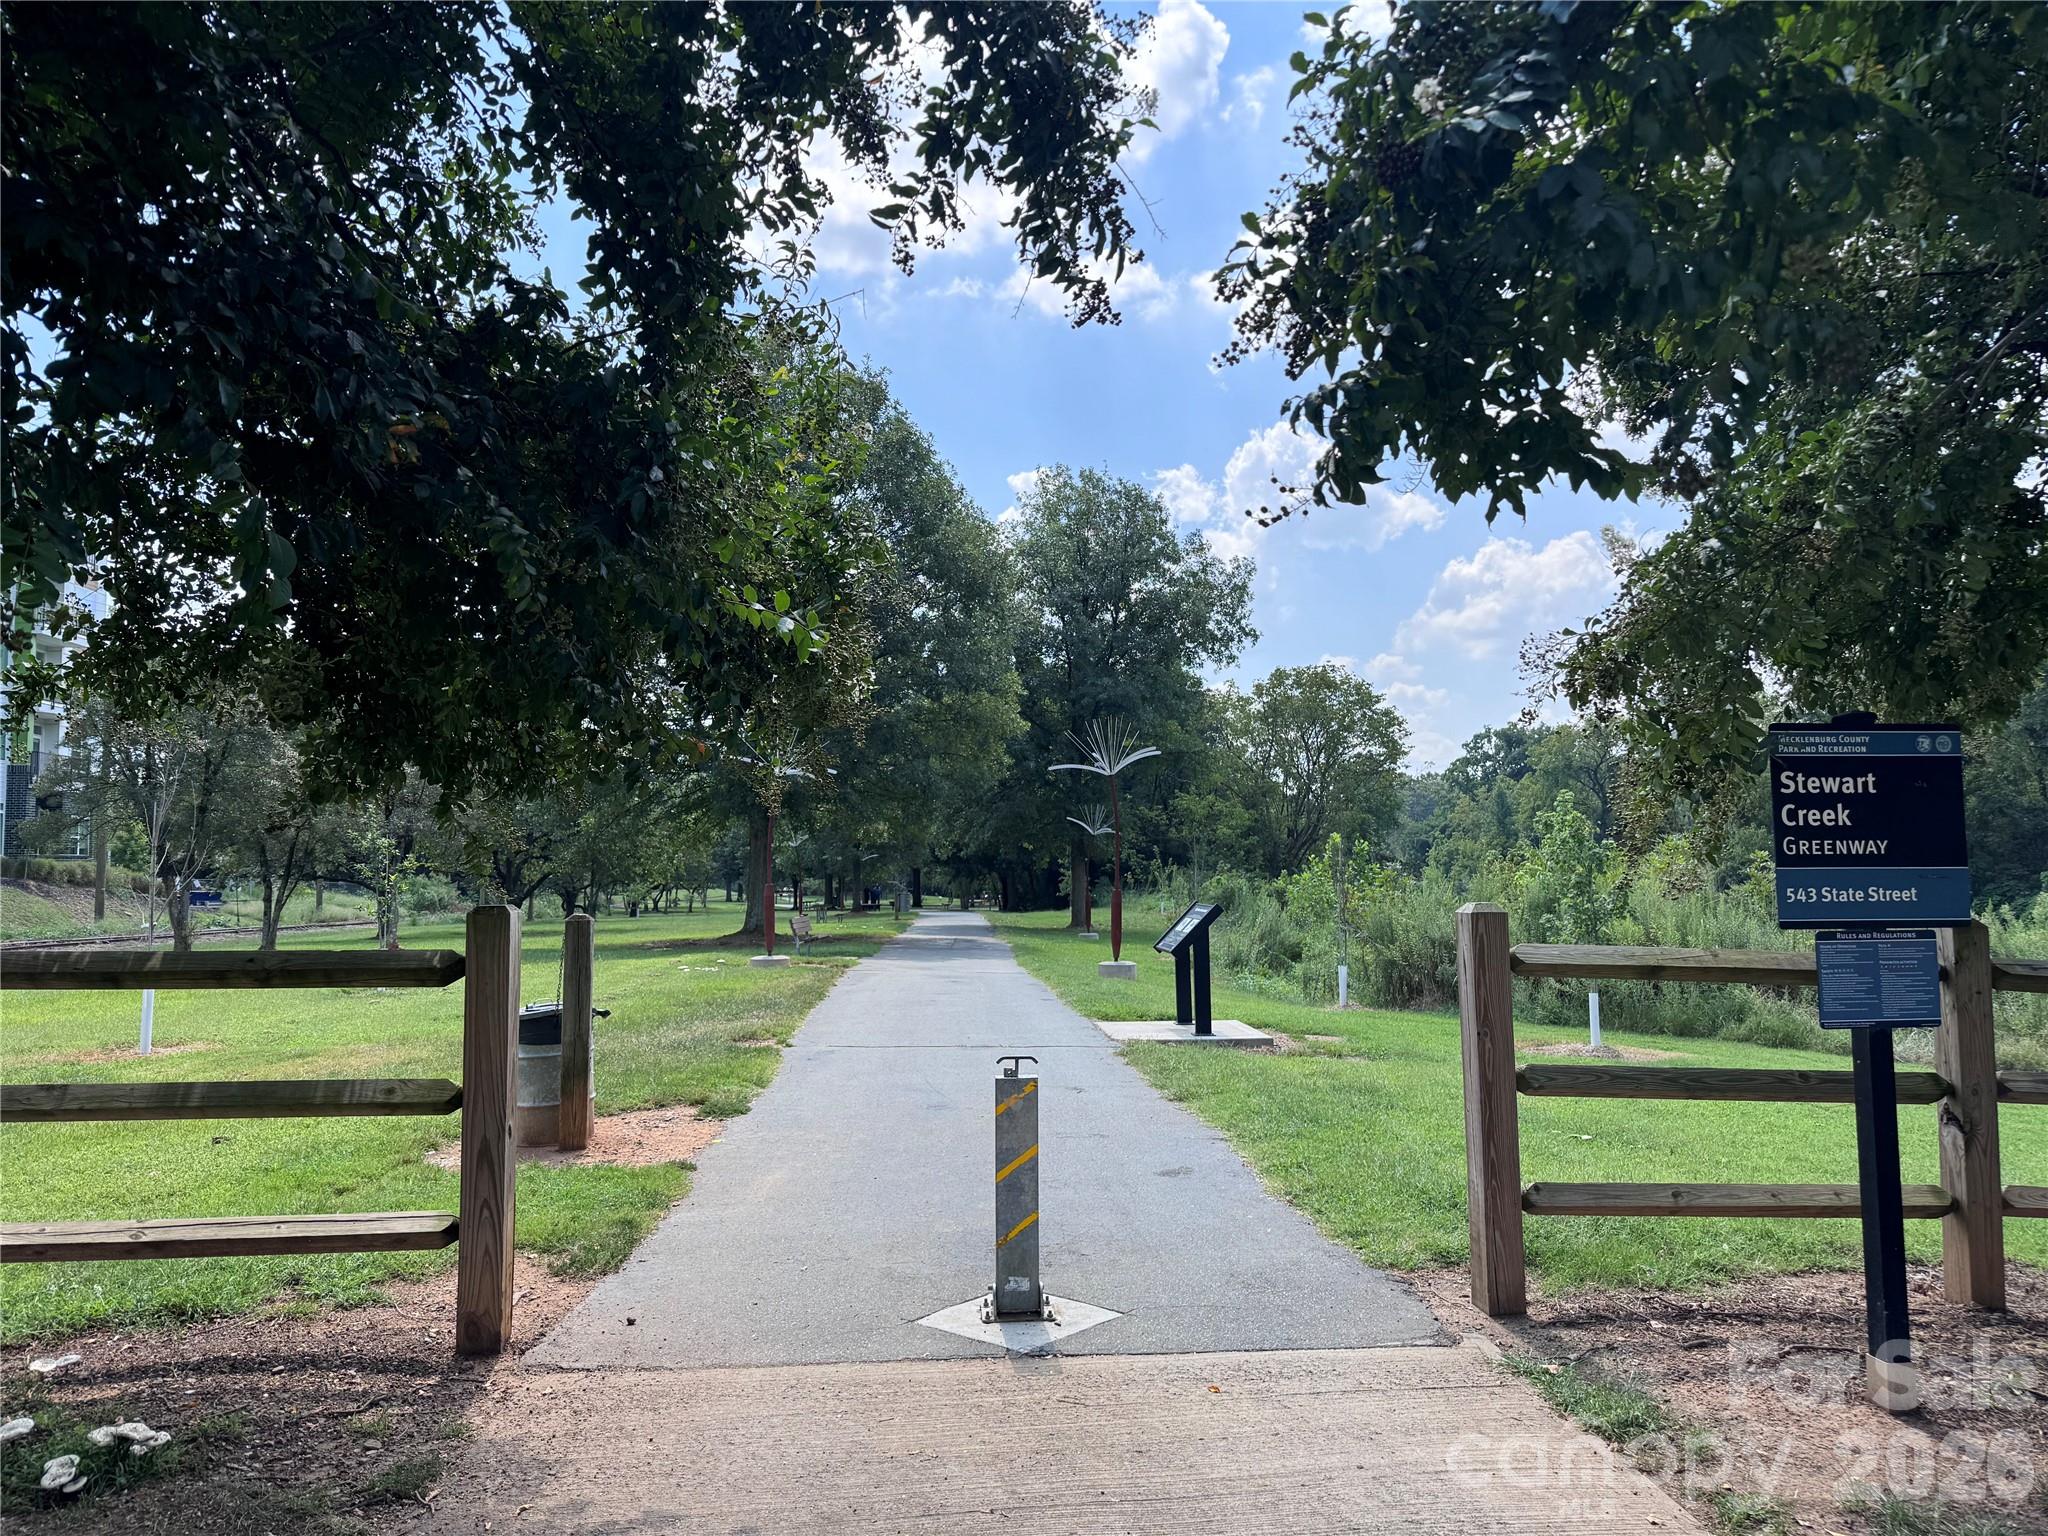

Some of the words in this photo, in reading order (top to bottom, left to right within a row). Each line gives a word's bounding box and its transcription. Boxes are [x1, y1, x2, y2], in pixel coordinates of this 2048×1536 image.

[1838, 734, 1870, 743] COUNTY
[1778, 744, 1799, 753] PARK
[1818, 744, 1867, 753] RECREATION
[1780, 770, 1877, 795] Stewart
[1781, 802, 1852, 827] Creek
[1783, 836, 1889, 855] GREENWAY
[1786, 887, 1817, 903] 543
[1821, 887, 1865, 902] State
[1868, 886, 1918, 902] Street
[1872, 931, 1917, 939] REGULATIONS
